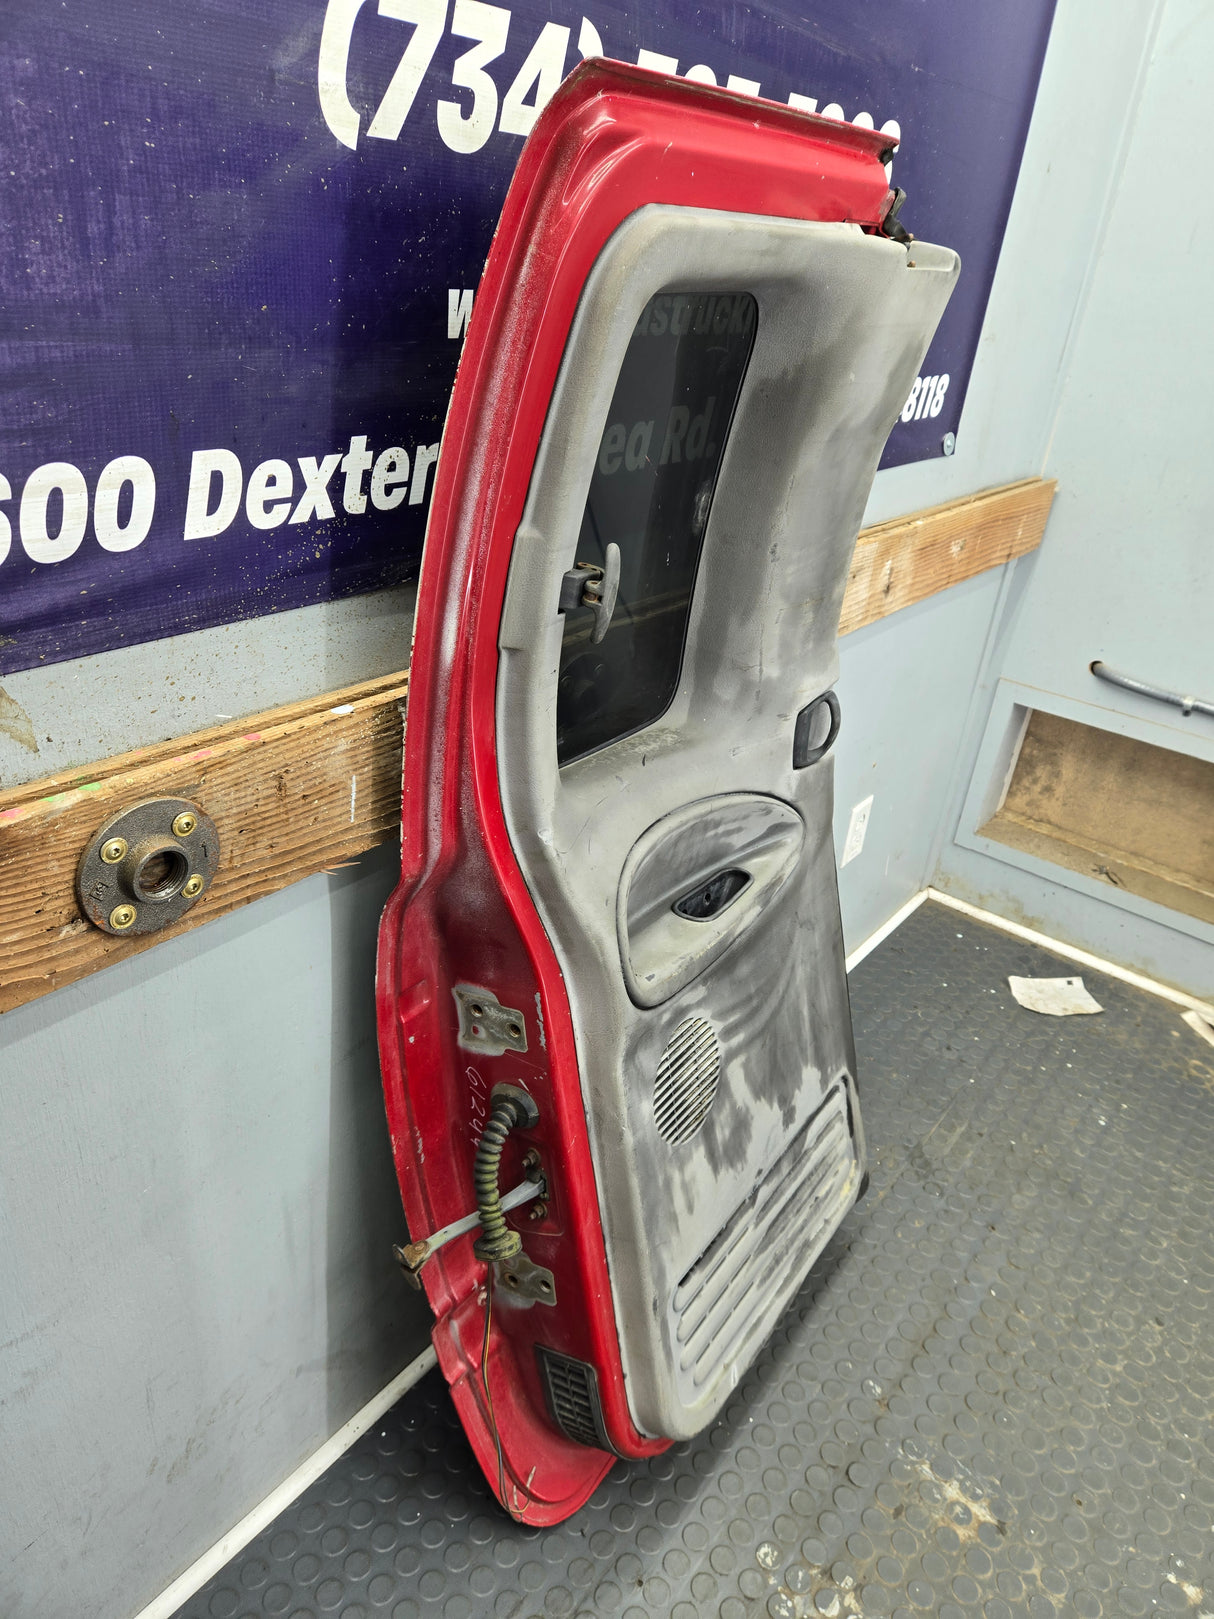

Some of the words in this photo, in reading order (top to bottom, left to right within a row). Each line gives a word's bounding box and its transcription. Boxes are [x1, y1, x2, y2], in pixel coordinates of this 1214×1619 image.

[317, 0, 604, 154] (734
[0, 455, 156, 564] 00
[183, 434, 440, 541] Dexter
[659, 396, 716, 465] Rd.
[896, 373, 950, 423] 8118
